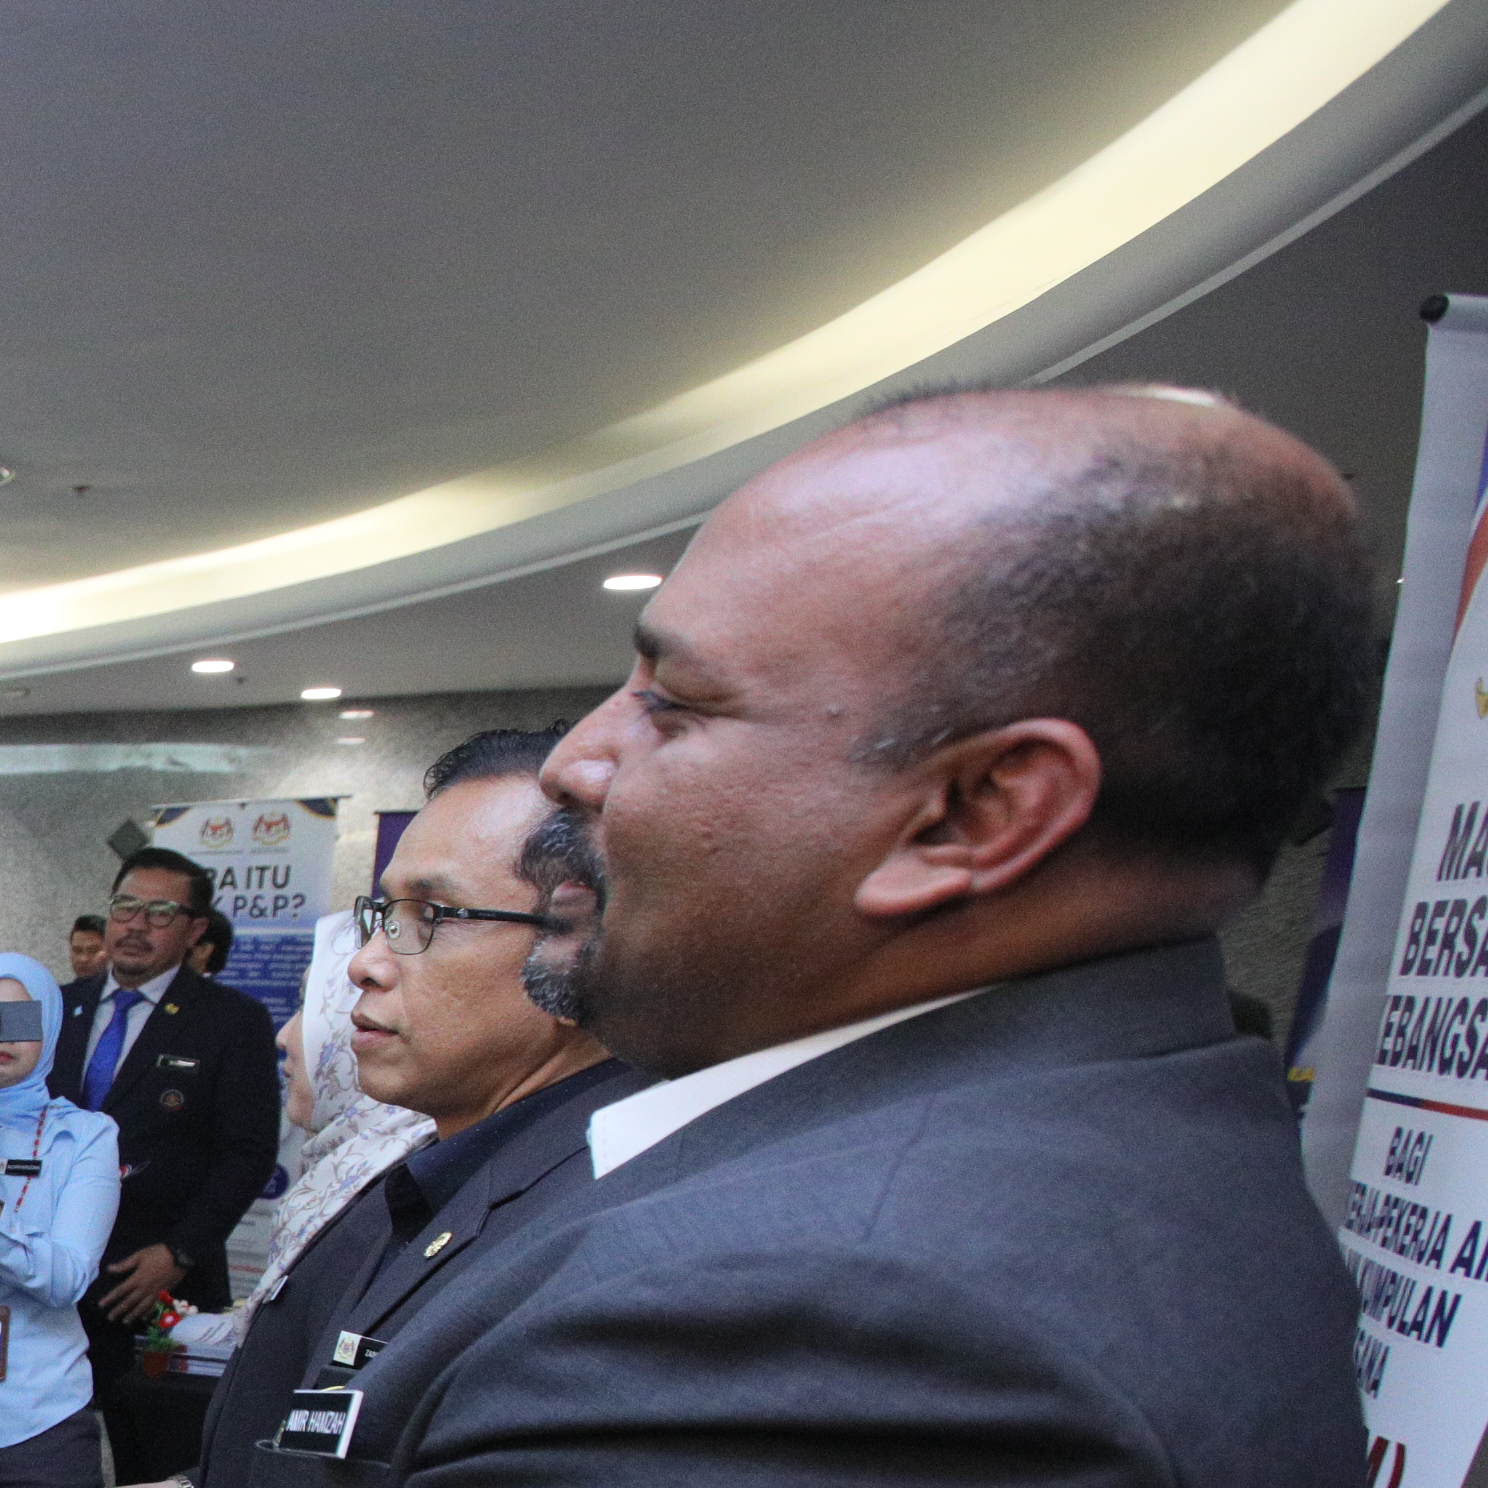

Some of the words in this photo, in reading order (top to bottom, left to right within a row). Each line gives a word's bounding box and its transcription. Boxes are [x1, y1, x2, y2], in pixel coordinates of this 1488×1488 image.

[232, 892, 307, 918] P&P?
[246, 864, 292, 889] ITU
[1399, 895, 1488, 978] BERSA
[1377, 994, 1488, 1080] EBANGSA
[1383, 1125, 1434, 1186] BAGI
[1450, 1219, 1488, 1282] A
[286, 1409, 309, 1432] AMIR
[308, 1410, 346, 1435] HAMZAH
